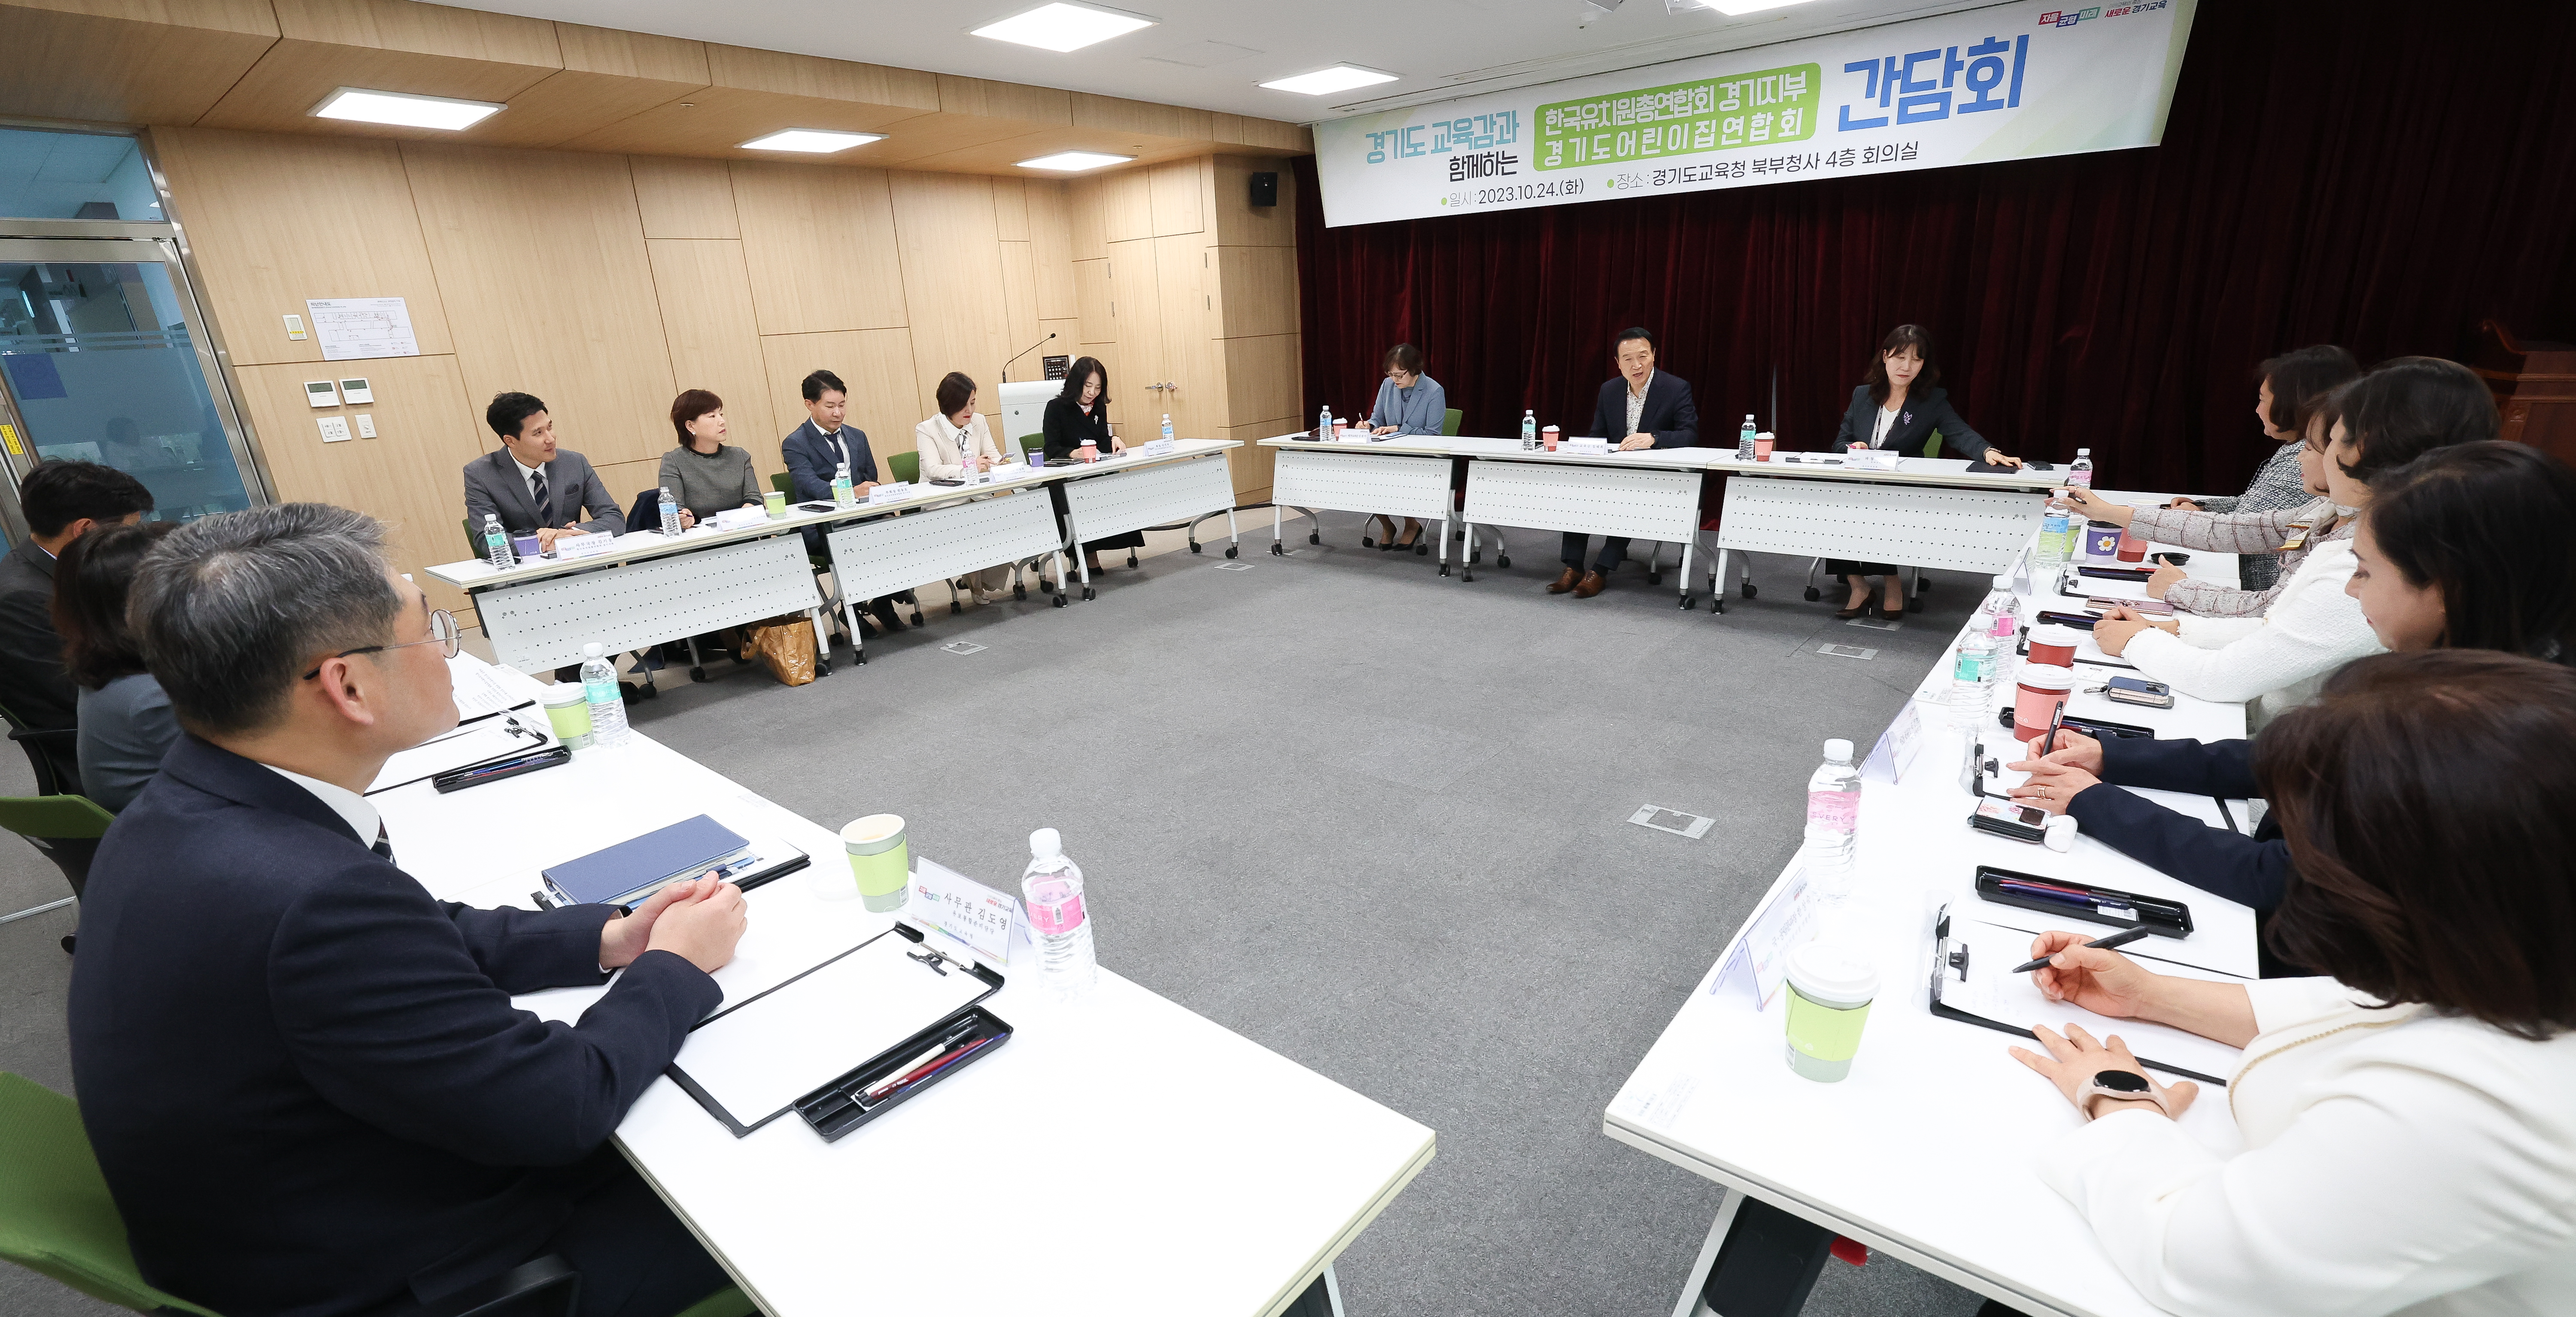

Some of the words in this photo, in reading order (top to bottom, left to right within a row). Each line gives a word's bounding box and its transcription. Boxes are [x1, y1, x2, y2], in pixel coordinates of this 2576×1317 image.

[2041, 12, 2059, 22] 자율
[2059, 15, 2078, 25] 균형
[2079, 9, 2098, 19] 미래
[2105, 6, 2131, 18] 새로운
[2132, 0, 2167, 14] 경기교육
[1838, 34, 2029, 132] 간담회
[1545, 85, 1714, 137] 한국유치원총연합회
[1718, 71, 1807, 112] 경기지부
[1366, 125, 1426, 164] 경기도
[1431, 110, 1519, 154] 교육감과
[1449, 150, 1519, 182] 함께하는
[1652, 161, 1746, 186] 경기도교육청
[1752, 152, 1820, 176] 북부청사
[1825, 149, 1856, 168] 4층
[1862, 141, 1919, 165] 회의실
[944, 892, 972, 914] 사무관
[978, 908, 1007, 930] 김도영
